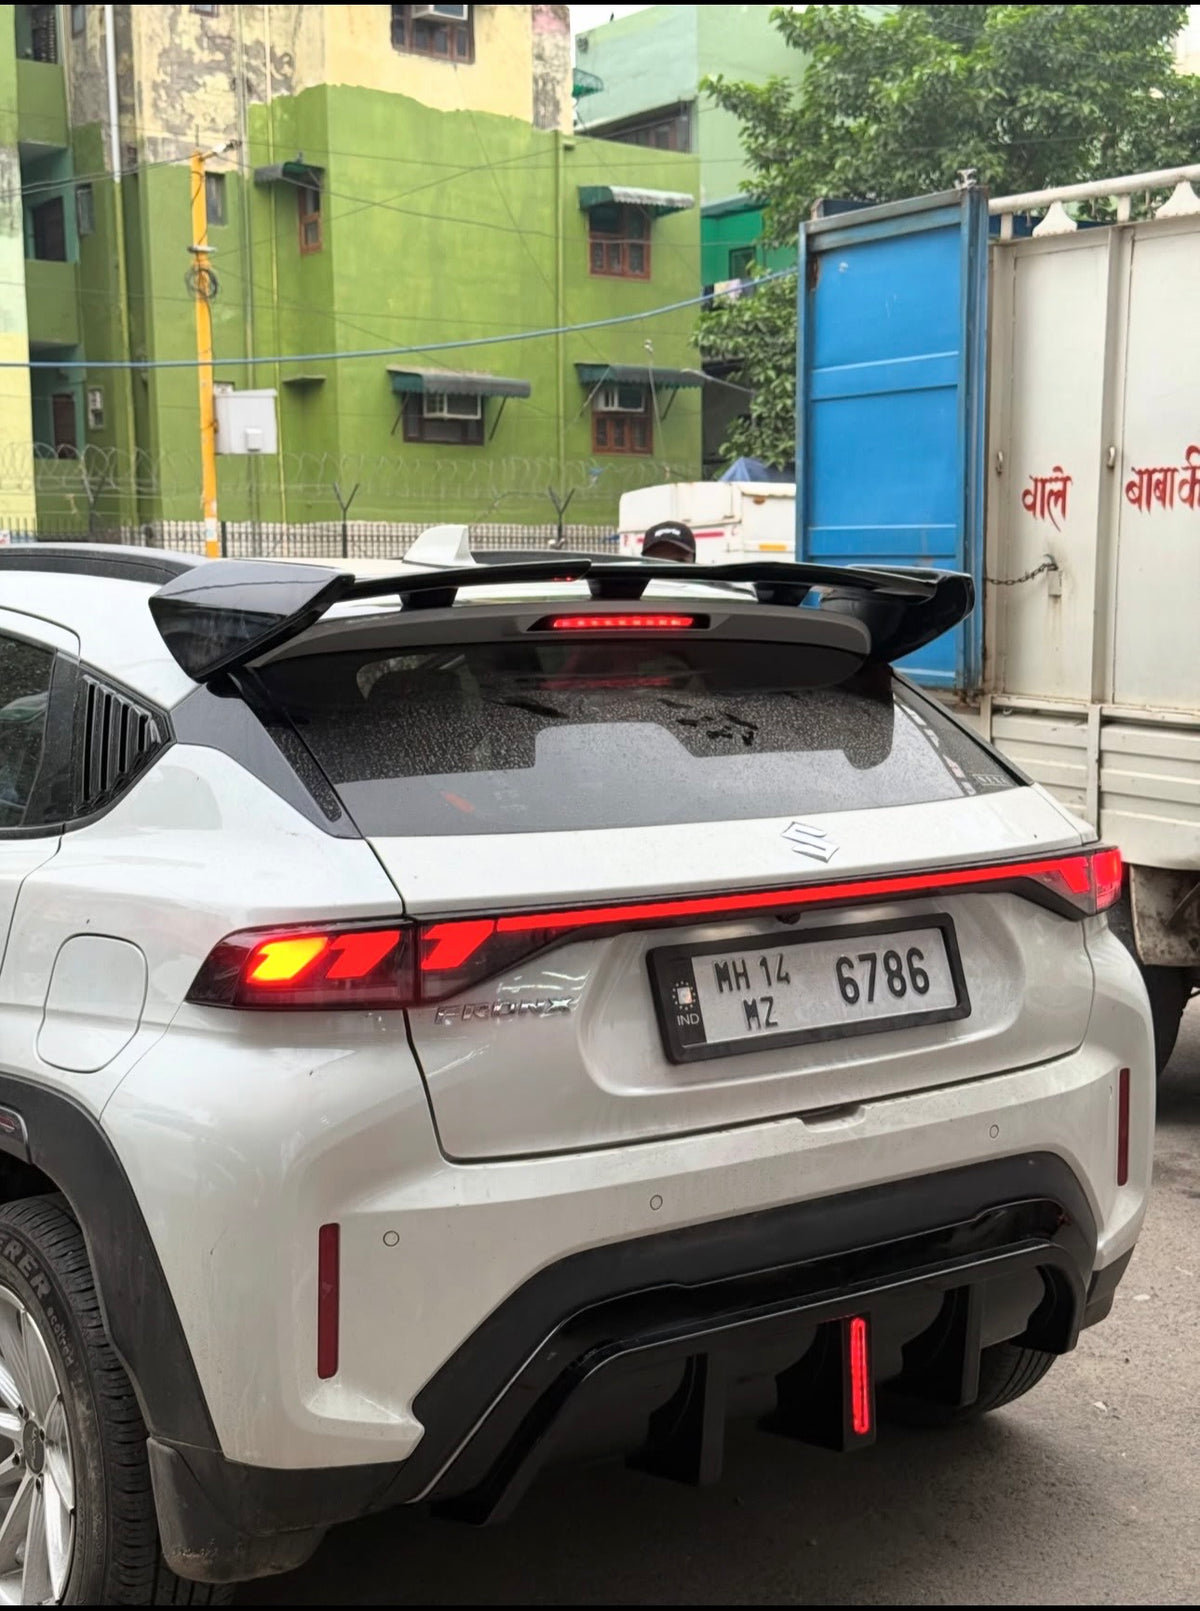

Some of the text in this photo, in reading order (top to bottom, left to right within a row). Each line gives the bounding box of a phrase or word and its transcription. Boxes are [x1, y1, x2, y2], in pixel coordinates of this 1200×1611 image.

[1022, 466, 1073, 532] वाले
[714, 953, 791, 993] MH 14
[836, 947, 930, 1005] 6786
[677, 1013, 700, 1026] IND
[743, 996, 778, 1031] MZ
